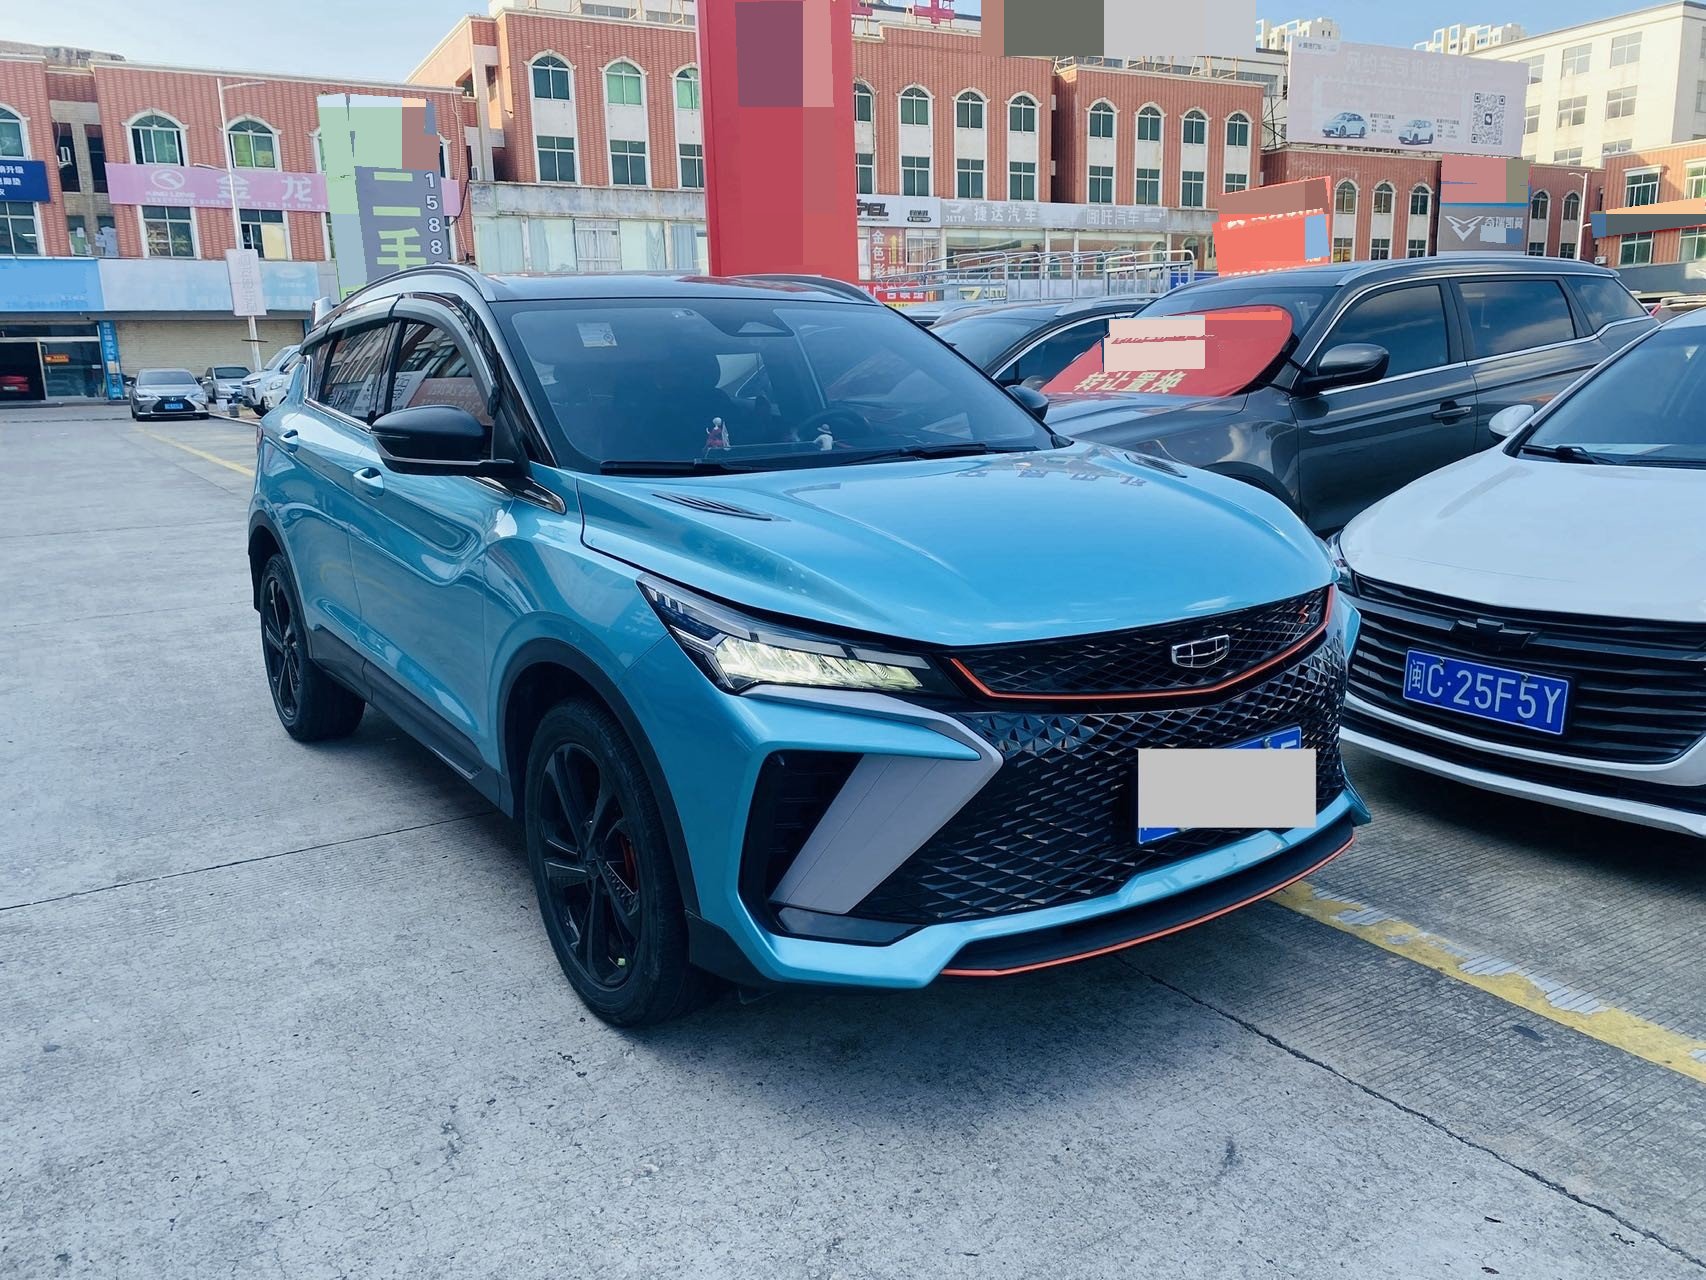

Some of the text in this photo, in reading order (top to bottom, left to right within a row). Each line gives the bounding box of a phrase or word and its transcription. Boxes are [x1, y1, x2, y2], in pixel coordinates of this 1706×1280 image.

[216, 174, 313, 203] 金龙
[425, 172, 443, 266] 1588
[945, 215, 966, 223] JETTA
[974, 205, 1038, 223] 捷达汽车
[1073, 371, 1187, 394] 转让置换
